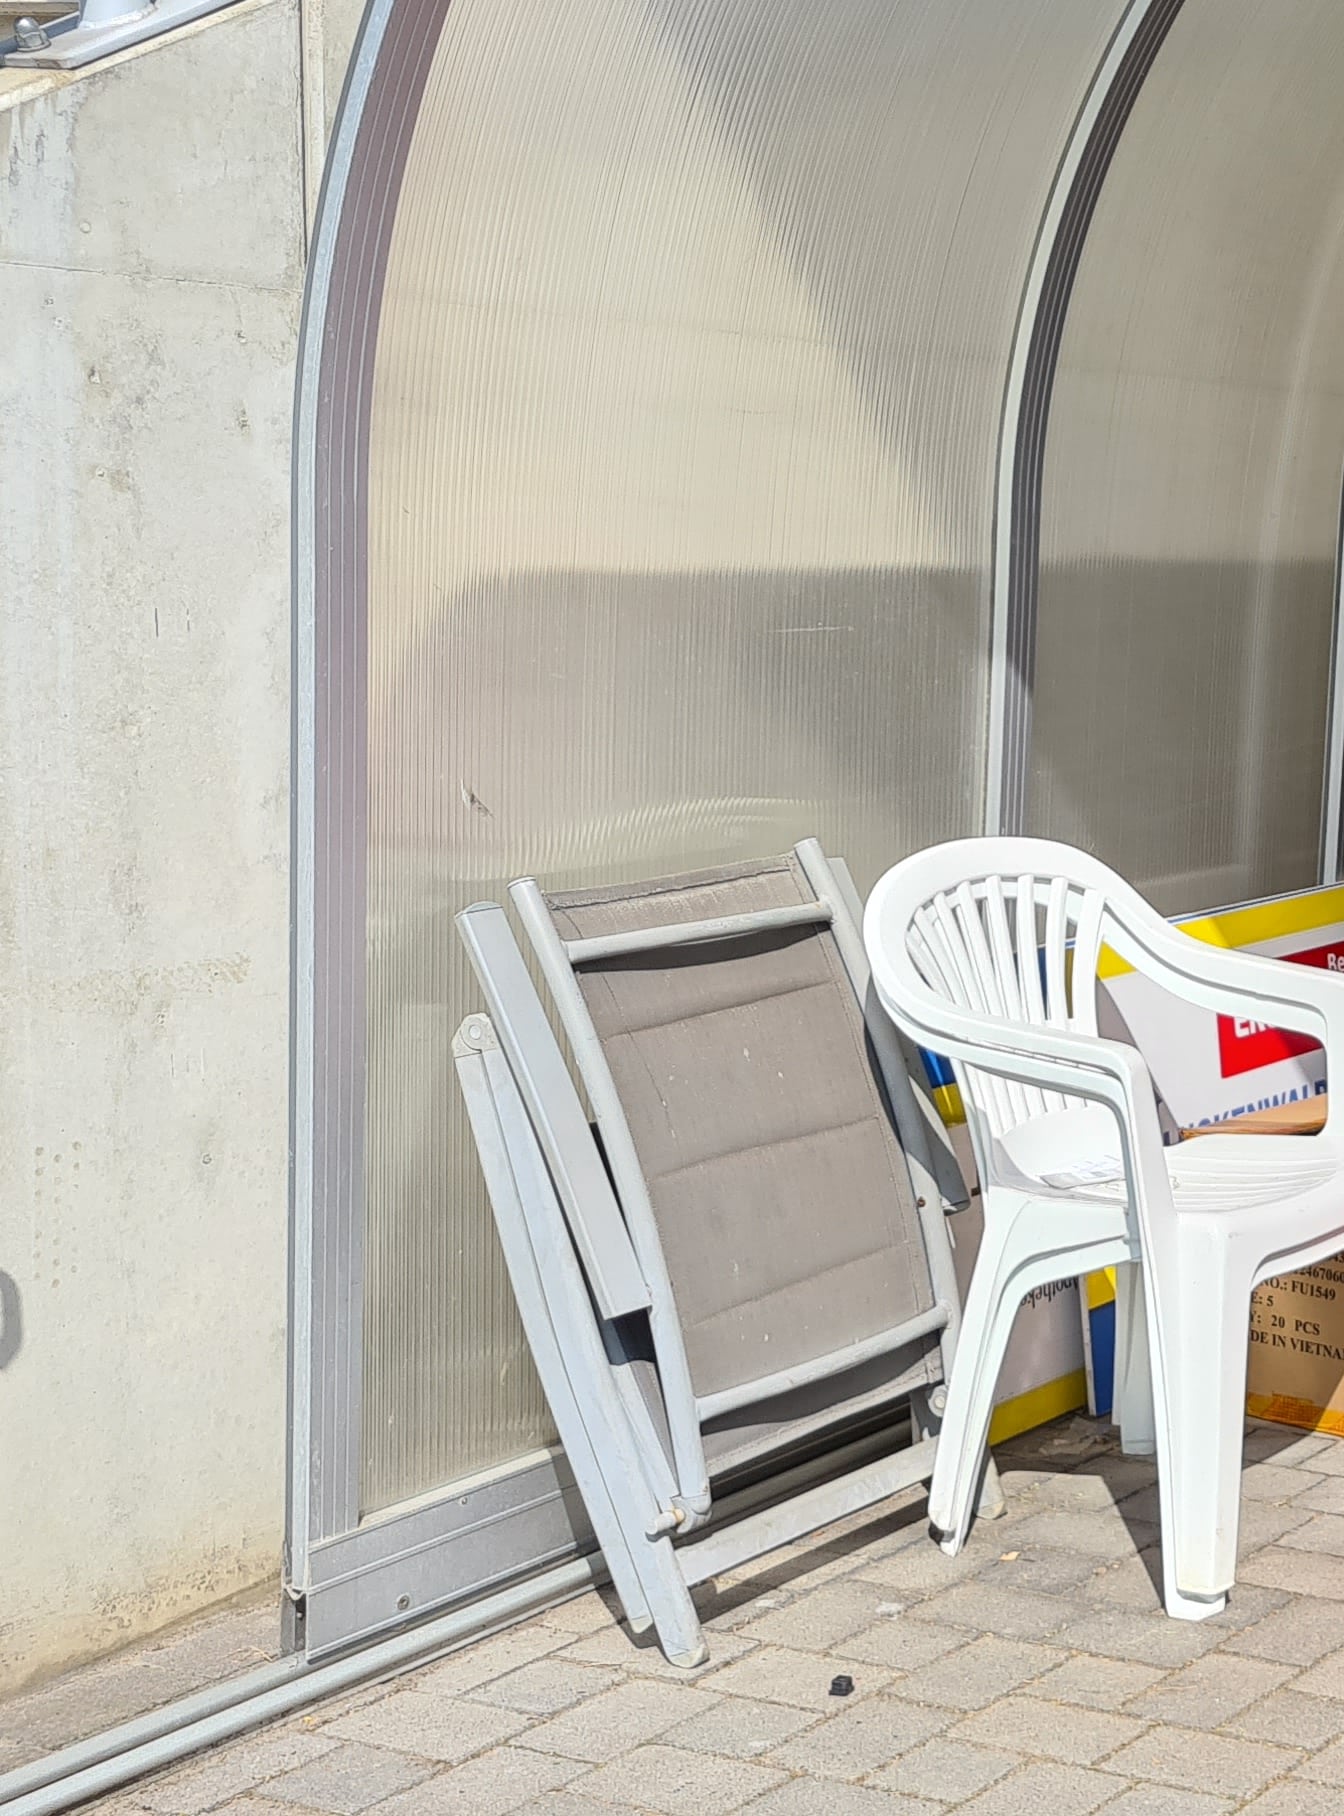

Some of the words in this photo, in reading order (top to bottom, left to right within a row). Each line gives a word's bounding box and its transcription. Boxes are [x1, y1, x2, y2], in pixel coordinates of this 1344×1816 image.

[1291, 1280, 1336, 1300] FU1549
[1266, 1295, 1275, 1307] 5
[1271, 1314, 1286, 1329] 20
[1294, 1319, 1321, 1336] PCS
[1250, 1329, 1268, 1345] DE
[1272, 1333, 1287, 1348] IN
